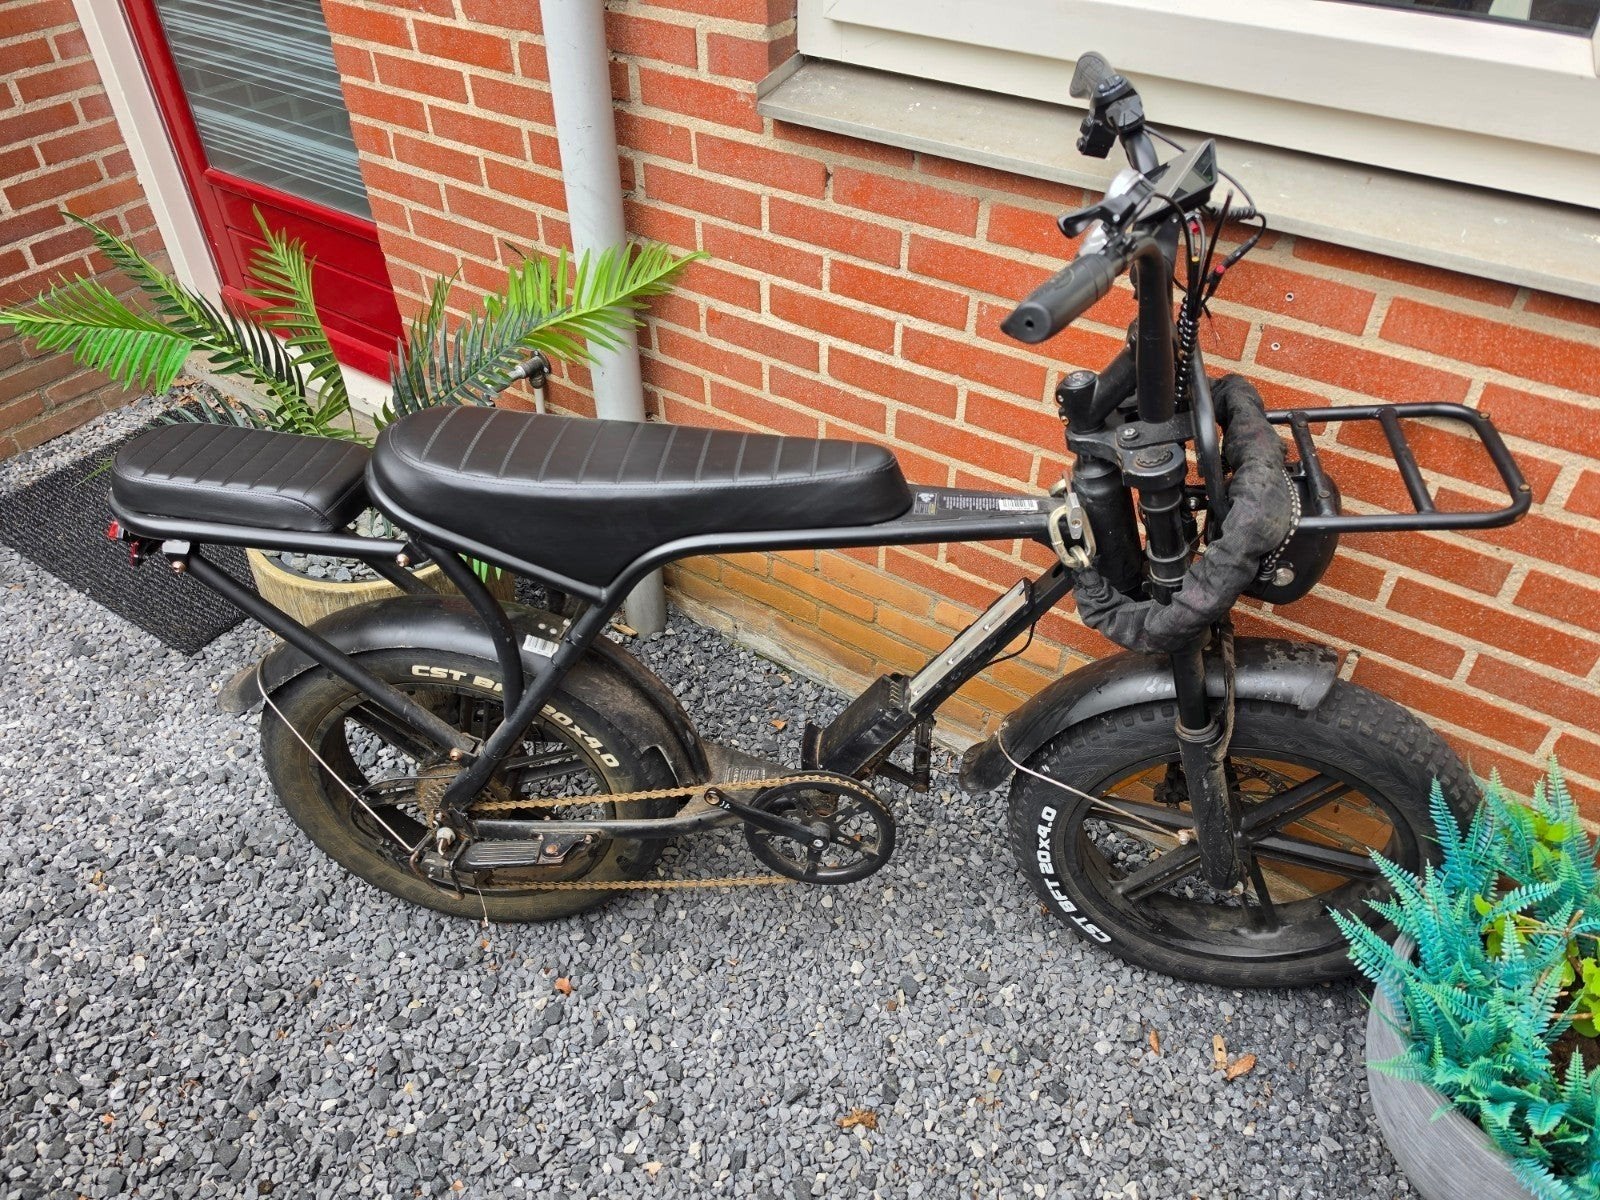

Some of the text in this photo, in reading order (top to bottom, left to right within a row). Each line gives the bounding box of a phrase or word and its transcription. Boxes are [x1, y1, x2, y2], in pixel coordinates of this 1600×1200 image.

[411, 664, 467, 681] CST
[1044, 878, 1078, 913] BFT
[1070, 915, 1112, 943] CST
